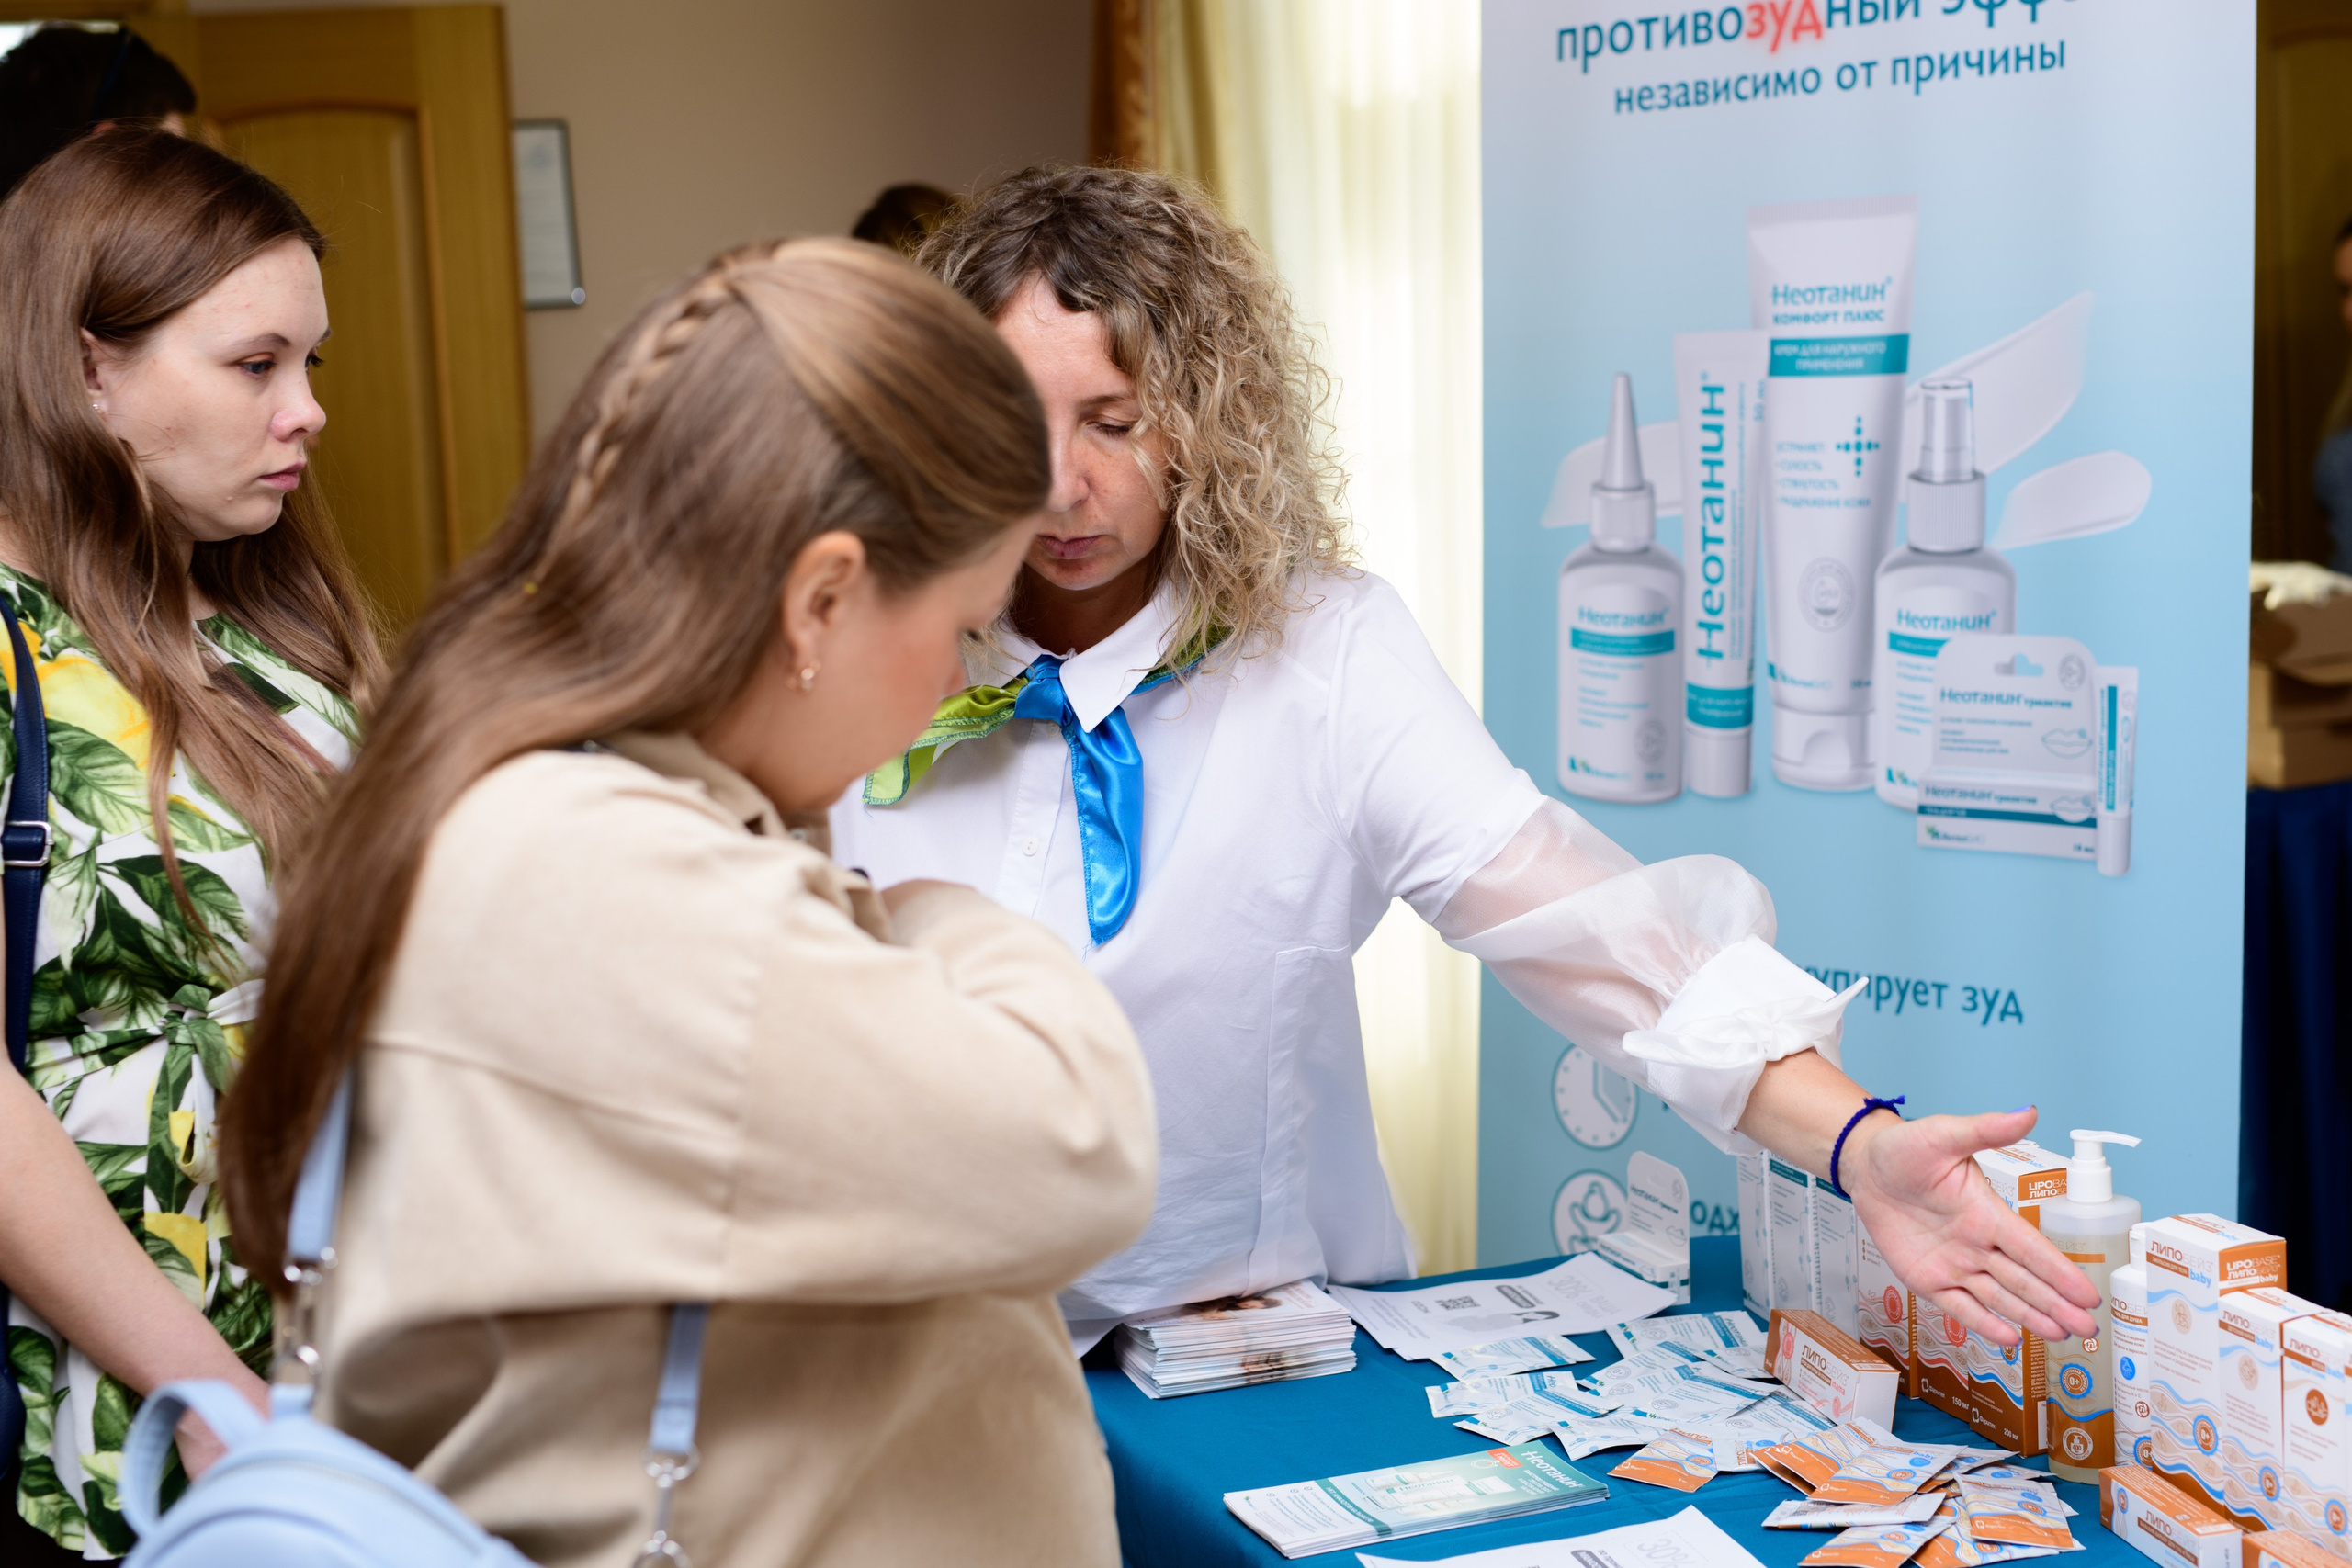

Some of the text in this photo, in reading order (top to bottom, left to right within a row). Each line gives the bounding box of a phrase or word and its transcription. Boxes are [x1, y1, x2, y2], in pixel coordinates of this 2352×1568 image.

[1614, 39, 2064, 114] независимо от причины
[1770, 283, 1885, 306] Неотанин
[1772, 310, 1885, 325] КОМФОРТ ПЛЮС
[1697, 386, 1725, 669] Неотанин
[1578, 606, 1665, 627] Неотанин
[1896, 608, 1992, 631] Неотанин
[1939, 688, 2021, 705] Неотанин
[1925, 785, 1993, 800] Неотанин
[1804, 966, 2024, 1027] упирует зуд
[2029, 1179, 2067, 1191] LIPOBA
[2029, 1187, 2067, 1200] ЛИПОБЕ
[2226, 1254, 2280, 1272] LIPOBASE
[2189, 1268, 2212, 1289] baby
[2260, 1273, 2278, 1284] baby
[2256, 1334, 2275, 1353] baby
[2069, 1376, 2081, 1386] 0+
[1951, 1395, 1962, 1406] 150
[2004, 1428, 2012, 1438] 200
[1913, 1450, 1936, 1461] baby
[1521, 1450, 1585, 1488] Неотанин
